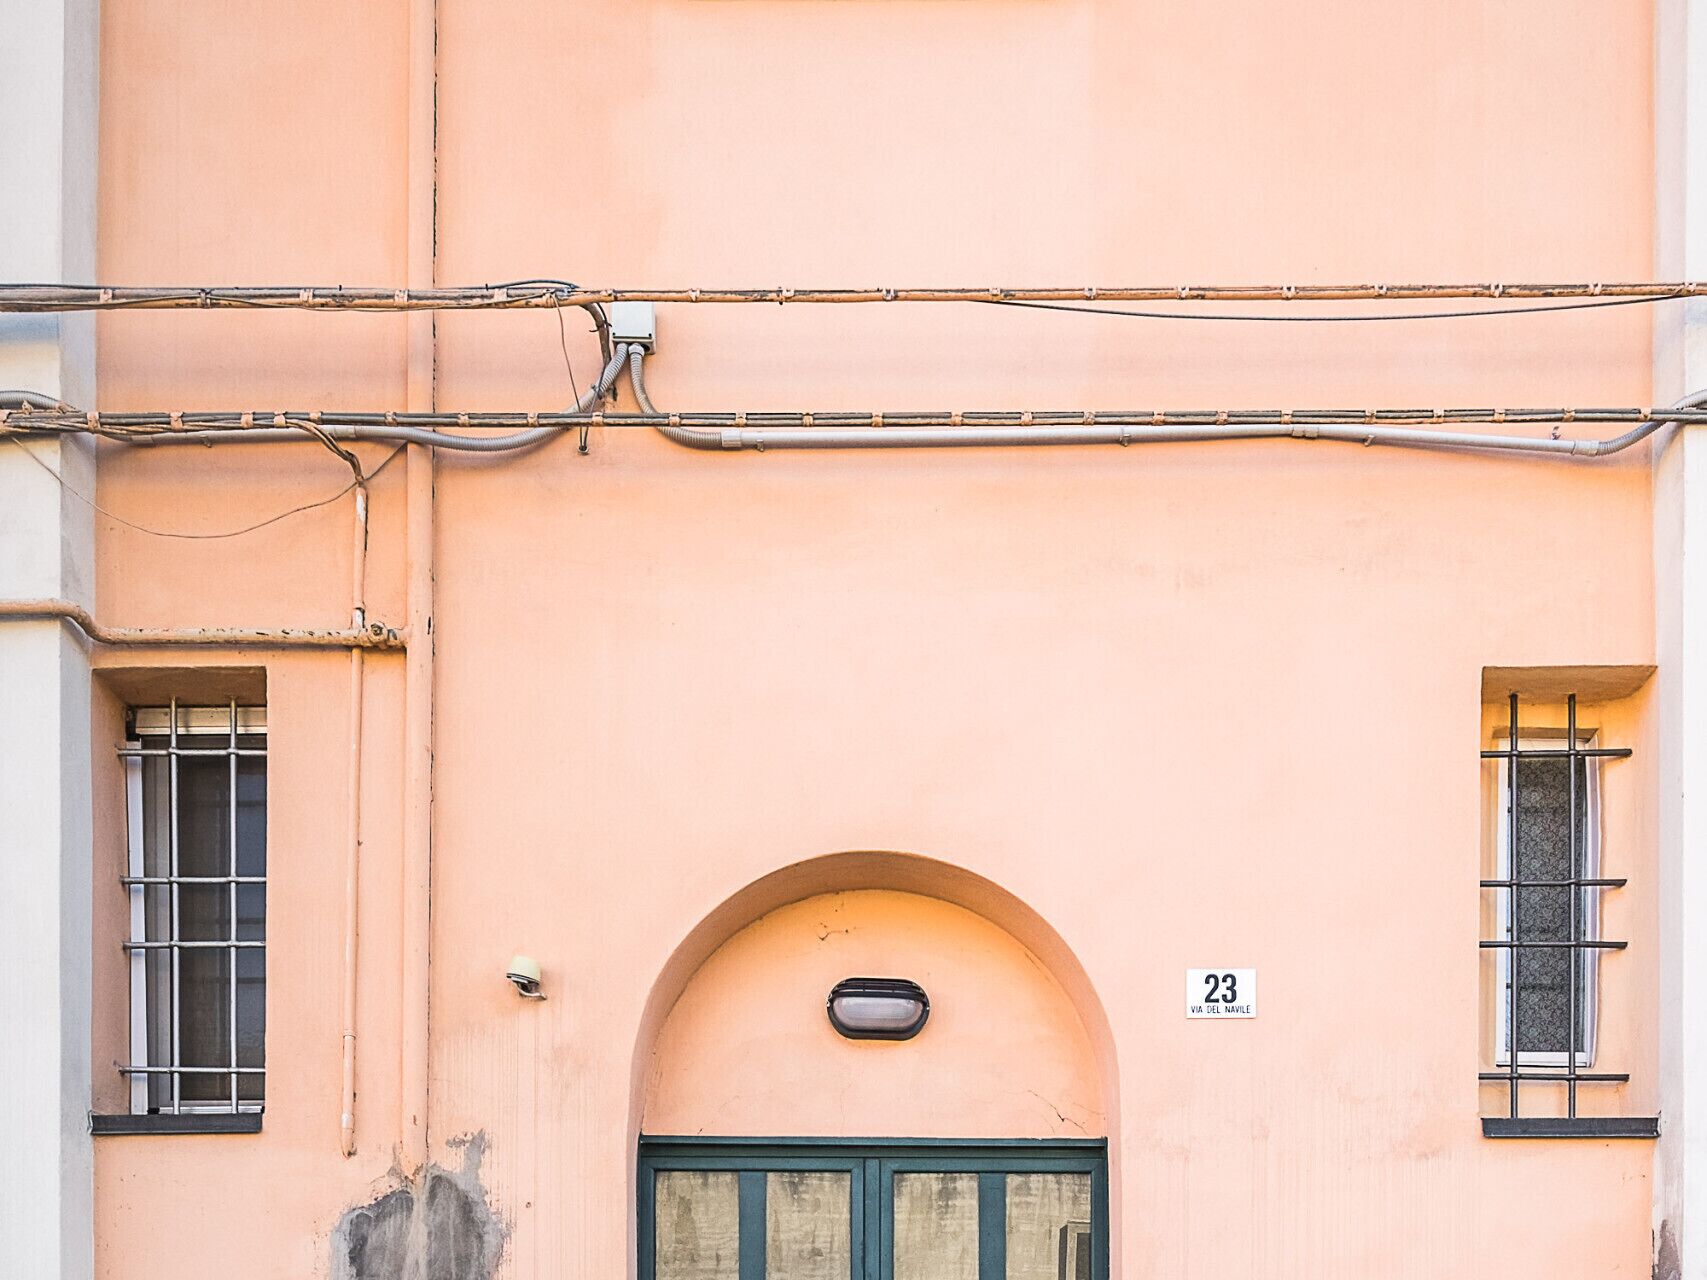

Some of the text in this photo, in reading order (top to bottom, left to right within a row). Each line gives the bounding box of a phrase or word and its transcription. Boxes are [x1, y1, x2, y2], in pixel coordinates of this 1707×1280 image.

[1204, 973, 1237, 1003] 23
[1190, 1005, 1251, 1014] VIA DEL NAVILE
